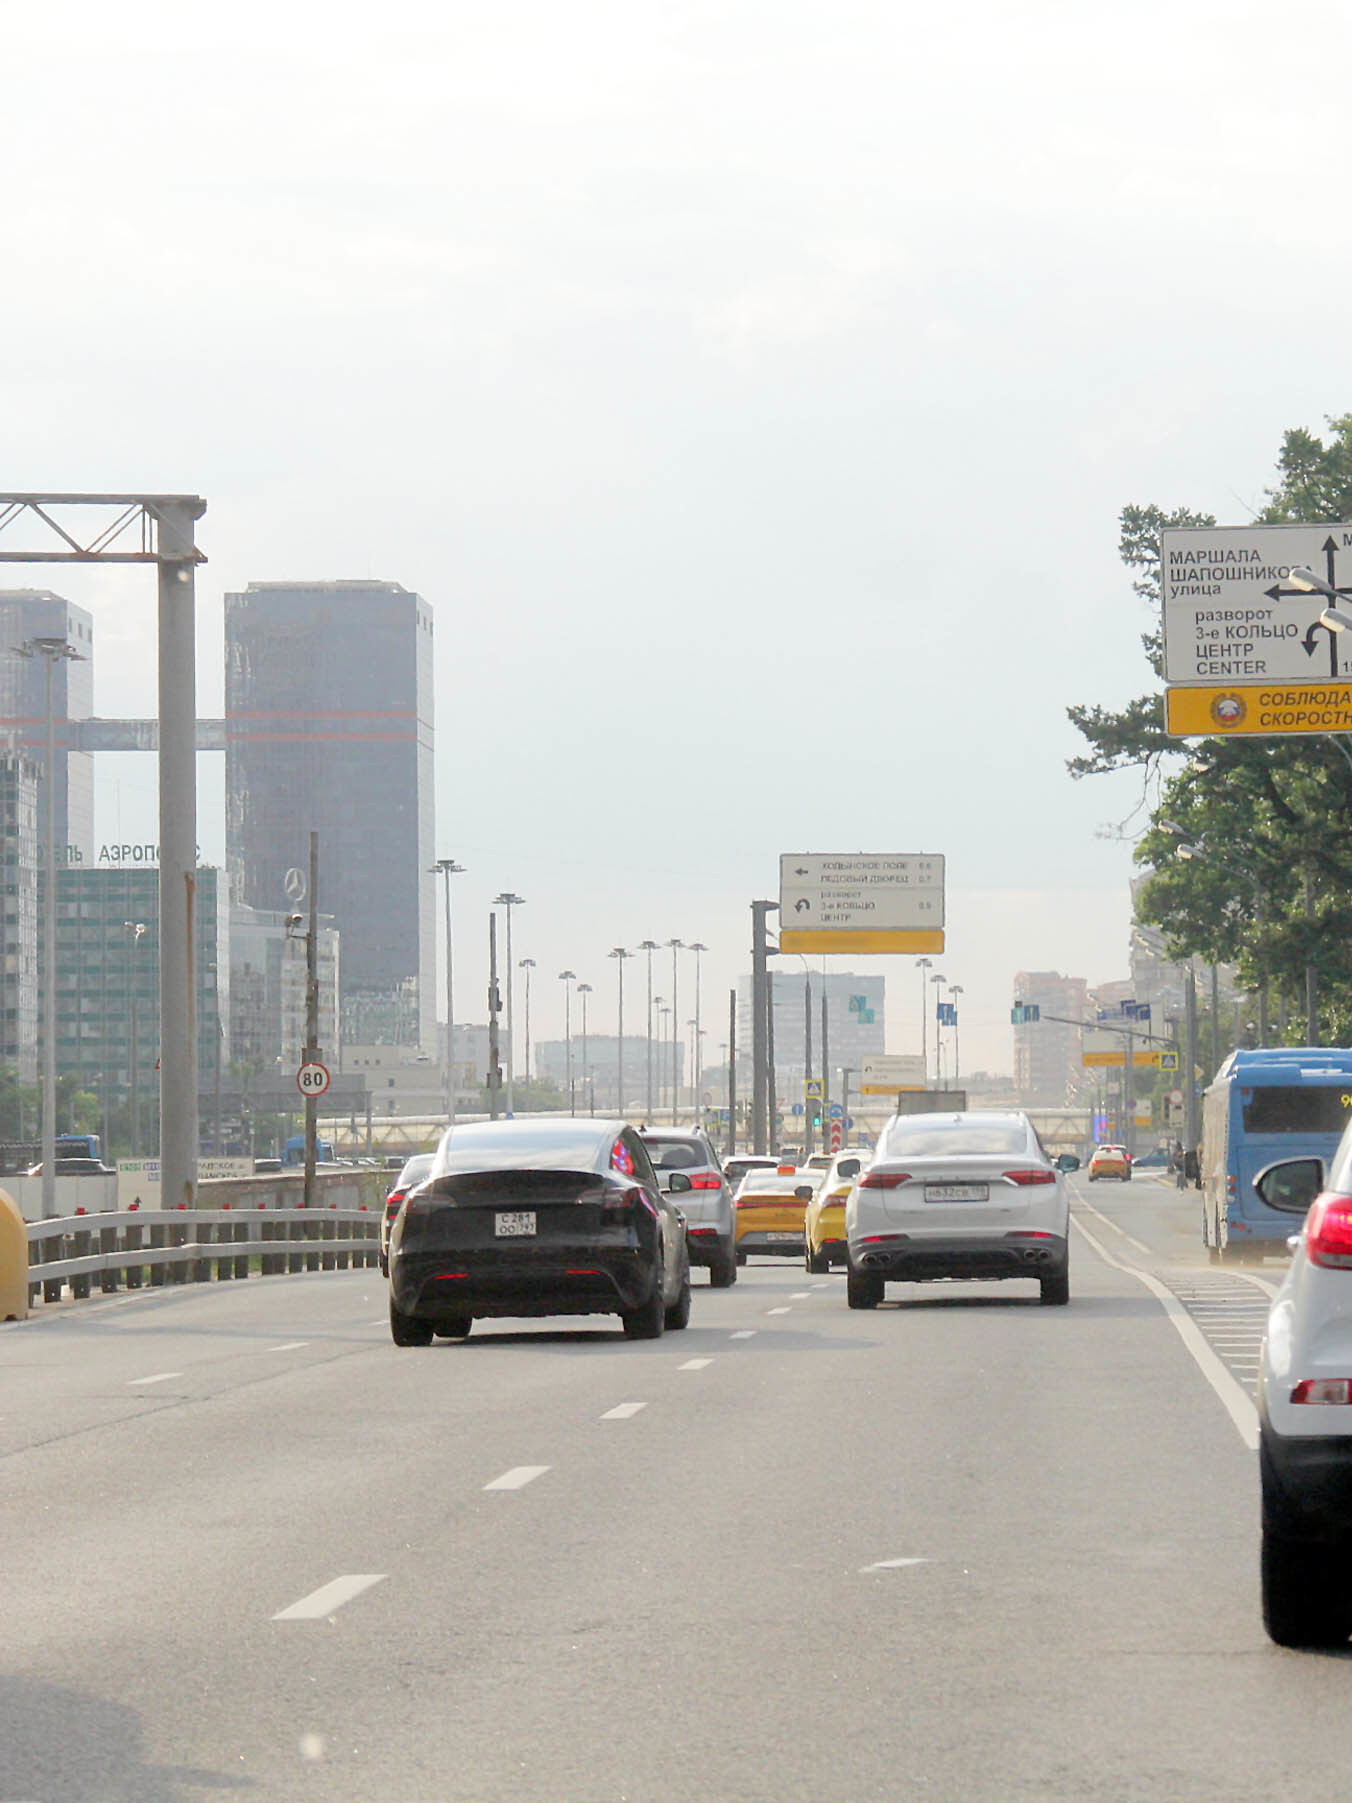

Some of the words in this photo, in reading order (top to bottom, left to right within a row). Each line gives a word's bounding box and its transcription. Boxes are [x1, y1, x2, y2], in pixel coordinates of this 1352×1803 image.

[1170, 550, 1262, 564] МАРШАЛА
[1170, 565, 1312, 582] ШАПОШНИКО
[1171, 585, 1221, 599] улица
[1195, 609, 1273, 624] разворот
[1196, 627, 1219, 640] 3-е
[1226, 624, 1298, 640] КОЛЬЦО
[1196, 644, 1254, 658] ЦЕНТР
[1196, 661, 1266, 675] CENTER
[99, 844, 201, 862] АЭРОПС
[303, 1072, 323, 1086] 80
